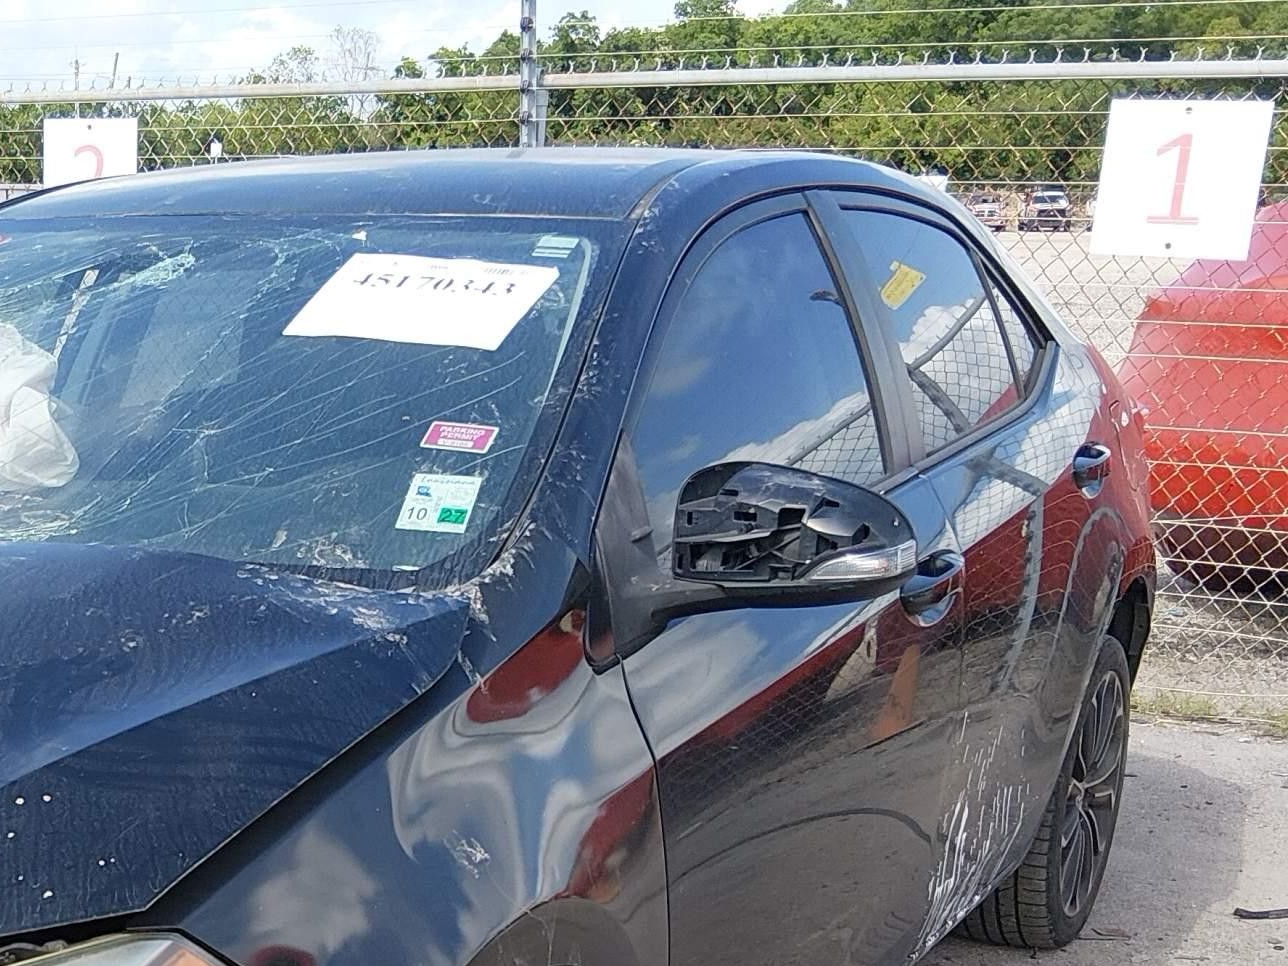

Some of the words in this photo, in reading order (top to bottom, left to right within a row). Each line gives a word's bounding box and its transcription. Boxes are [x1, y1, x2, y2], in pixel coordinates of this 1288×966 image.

[1146, 133, 1199, 226] 1
[352, 272, 517, 296] 45170343
[439, 426, 486, 437] PARKING
[439, 432, 481, 440] PERMIT
[407, 506, 428, 521] 10
[440, 508, 466, 523] 27
